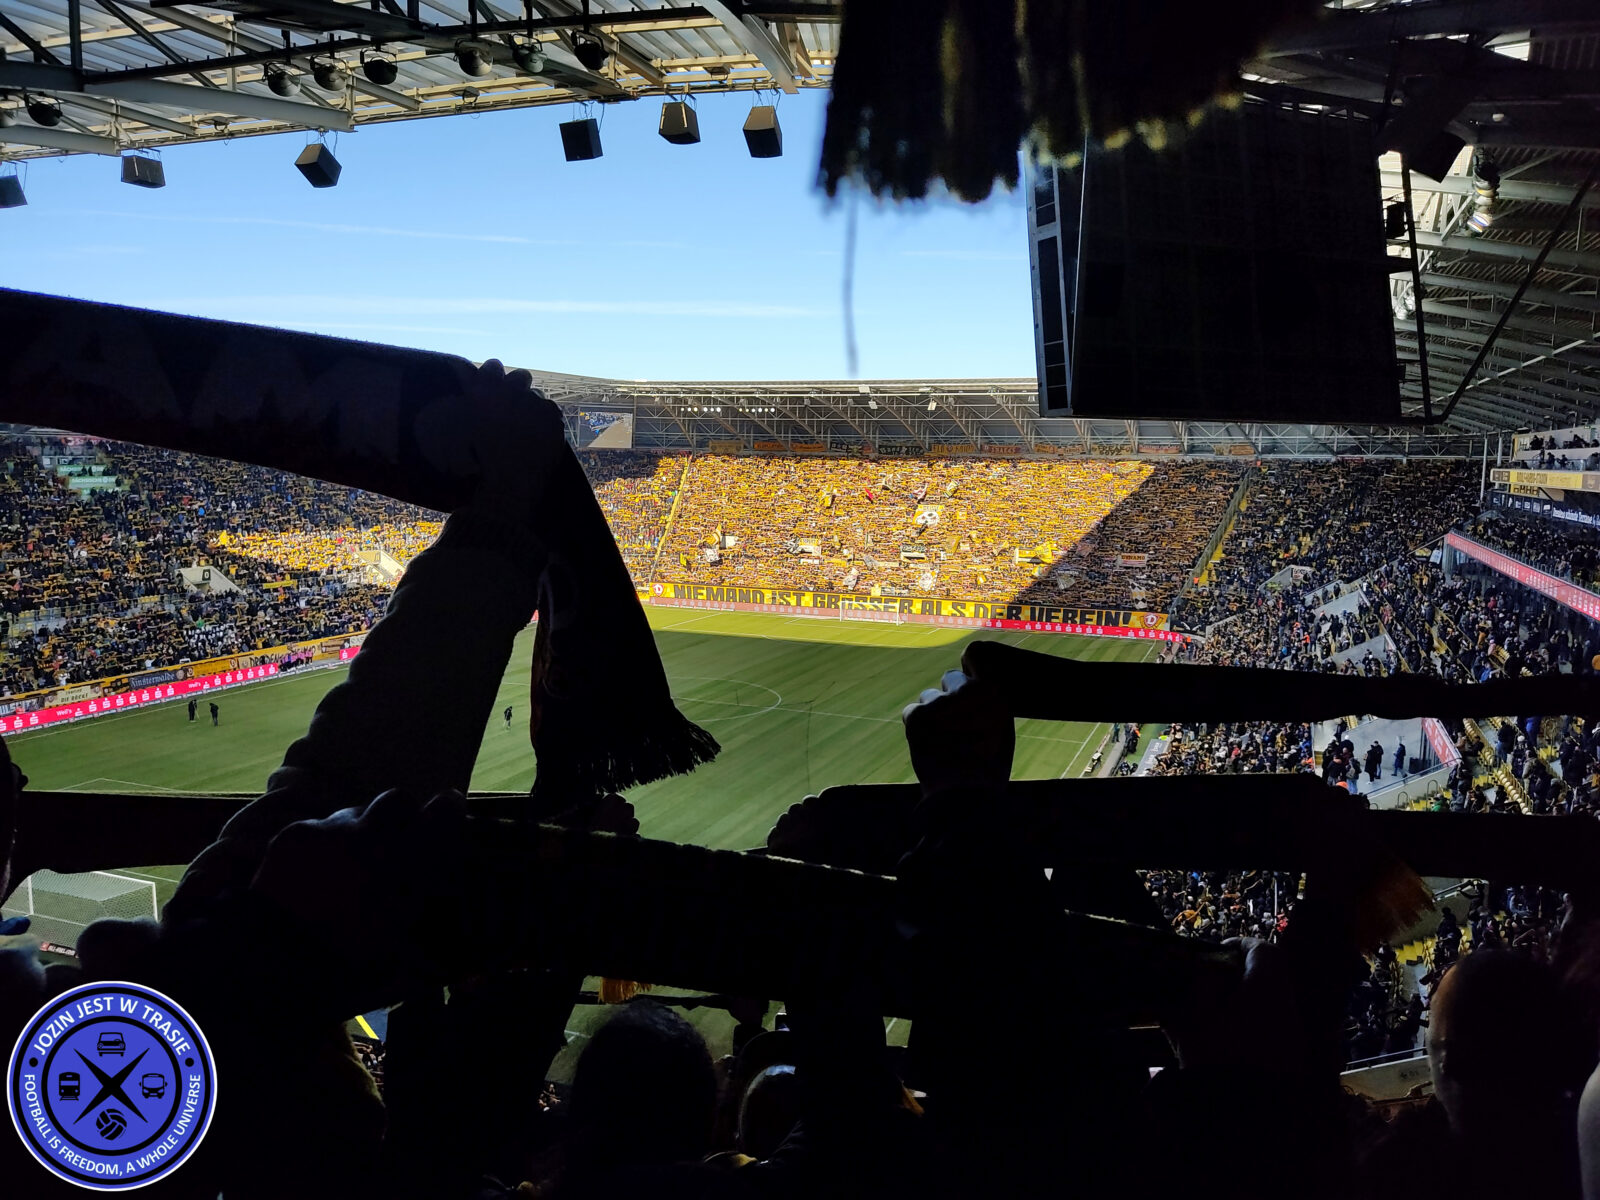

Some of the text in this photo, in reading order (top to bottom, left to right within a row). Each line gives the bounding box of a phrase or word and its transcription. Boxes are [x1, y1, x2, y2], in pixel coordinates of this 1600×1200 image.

[673, 584, 764, 605] NIEMAND
[921, 599, 967, 617] ALS
[974, 603, 1022, 621] DER
[1030, 606, 1132, 628] VEREIN!
